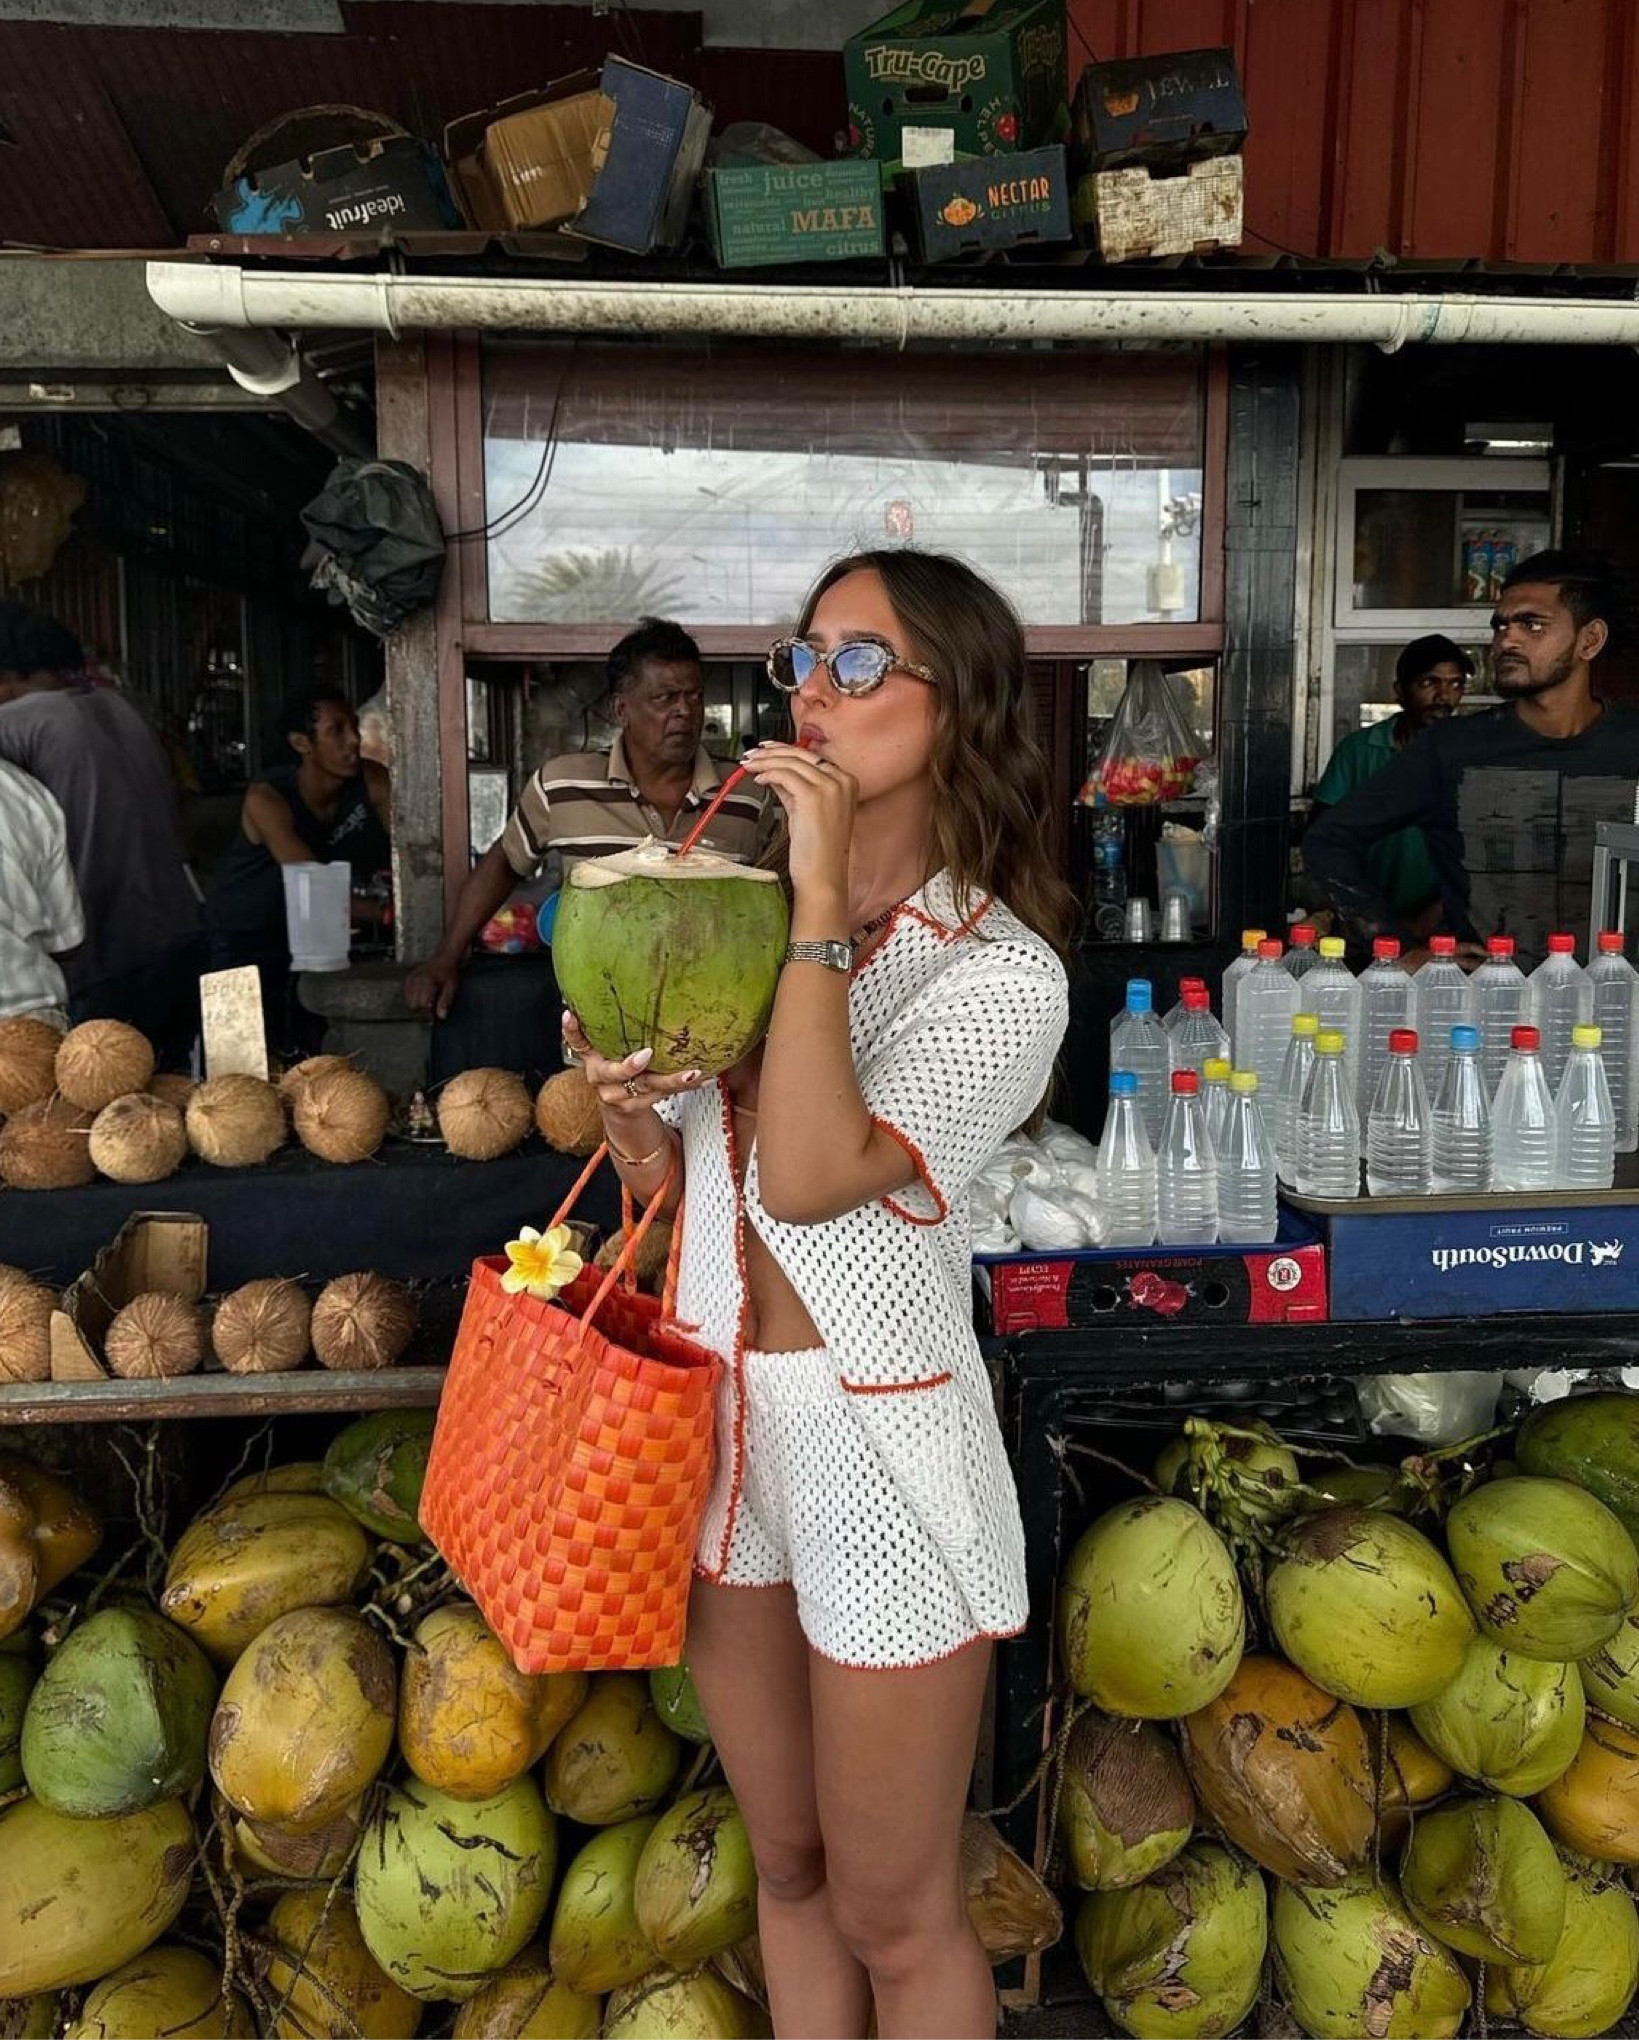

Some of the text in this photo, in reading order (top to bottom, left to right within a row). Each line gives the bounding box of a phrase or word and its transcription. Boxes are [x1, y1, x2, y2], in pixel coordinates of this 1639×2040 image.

[865, 45, 986, 93] Tru-Cape
[764, 170, 823, 196] juice
[987, 176, 1050, 208] NECTAR
[325, 193, 406, 231] ideafruit
[791, 206, 877, 233] MAFA
[1431, 1242, 1584, 1272] DownSouth
